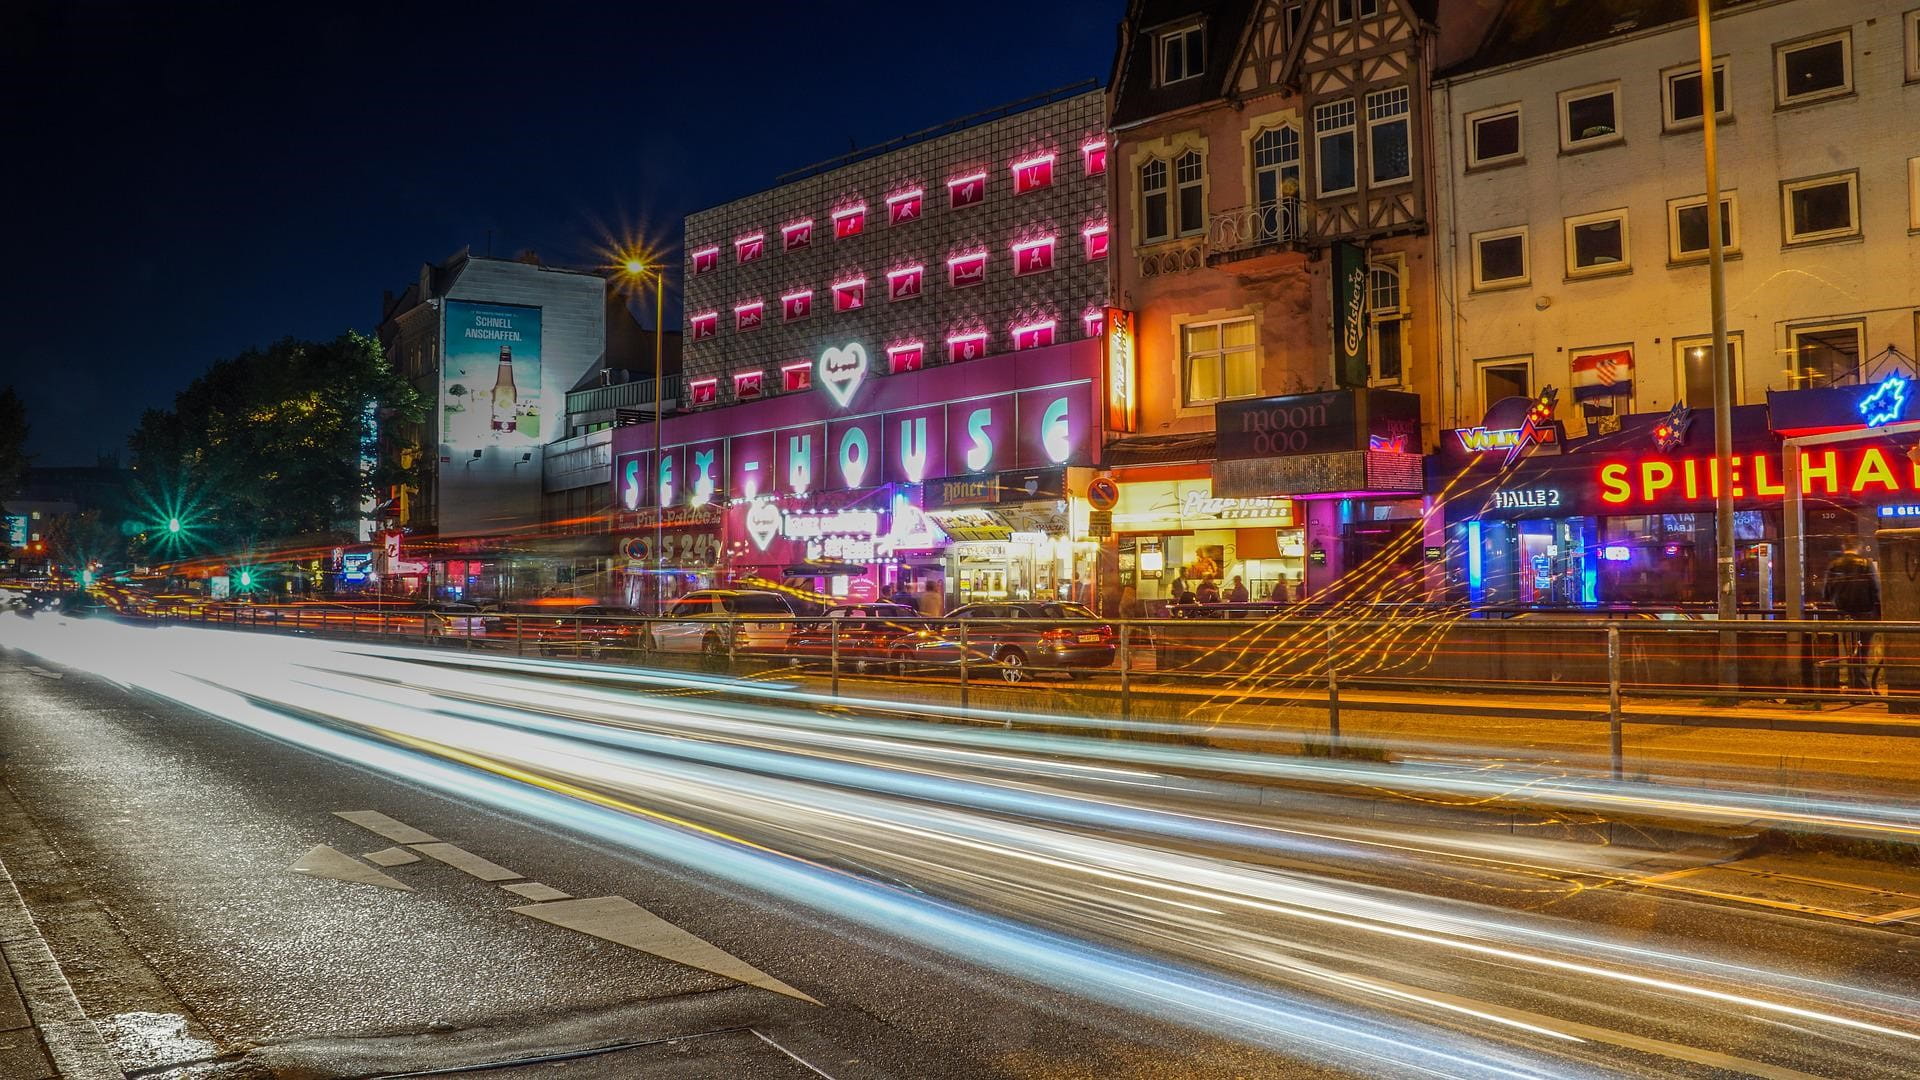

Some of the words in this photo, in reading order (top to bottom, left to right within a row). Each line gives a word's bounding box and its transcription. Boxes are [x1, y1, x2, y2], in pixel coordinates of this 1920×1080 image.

[1344, 267, 1365, 357] Carlsberg
[475, 315, 513, 329] SCHNELL
[464, 327, 522, 342] ANSCHAFFEN.
[1242, 403, 1330, 433] moon
[1600, 447, 1920, 503] SPIELHA
[1495, 491, 1547, 508] HALLE
[1548, 489, 1560, 506] 2
[1221, 508, 1288, 519] EXPRESS
